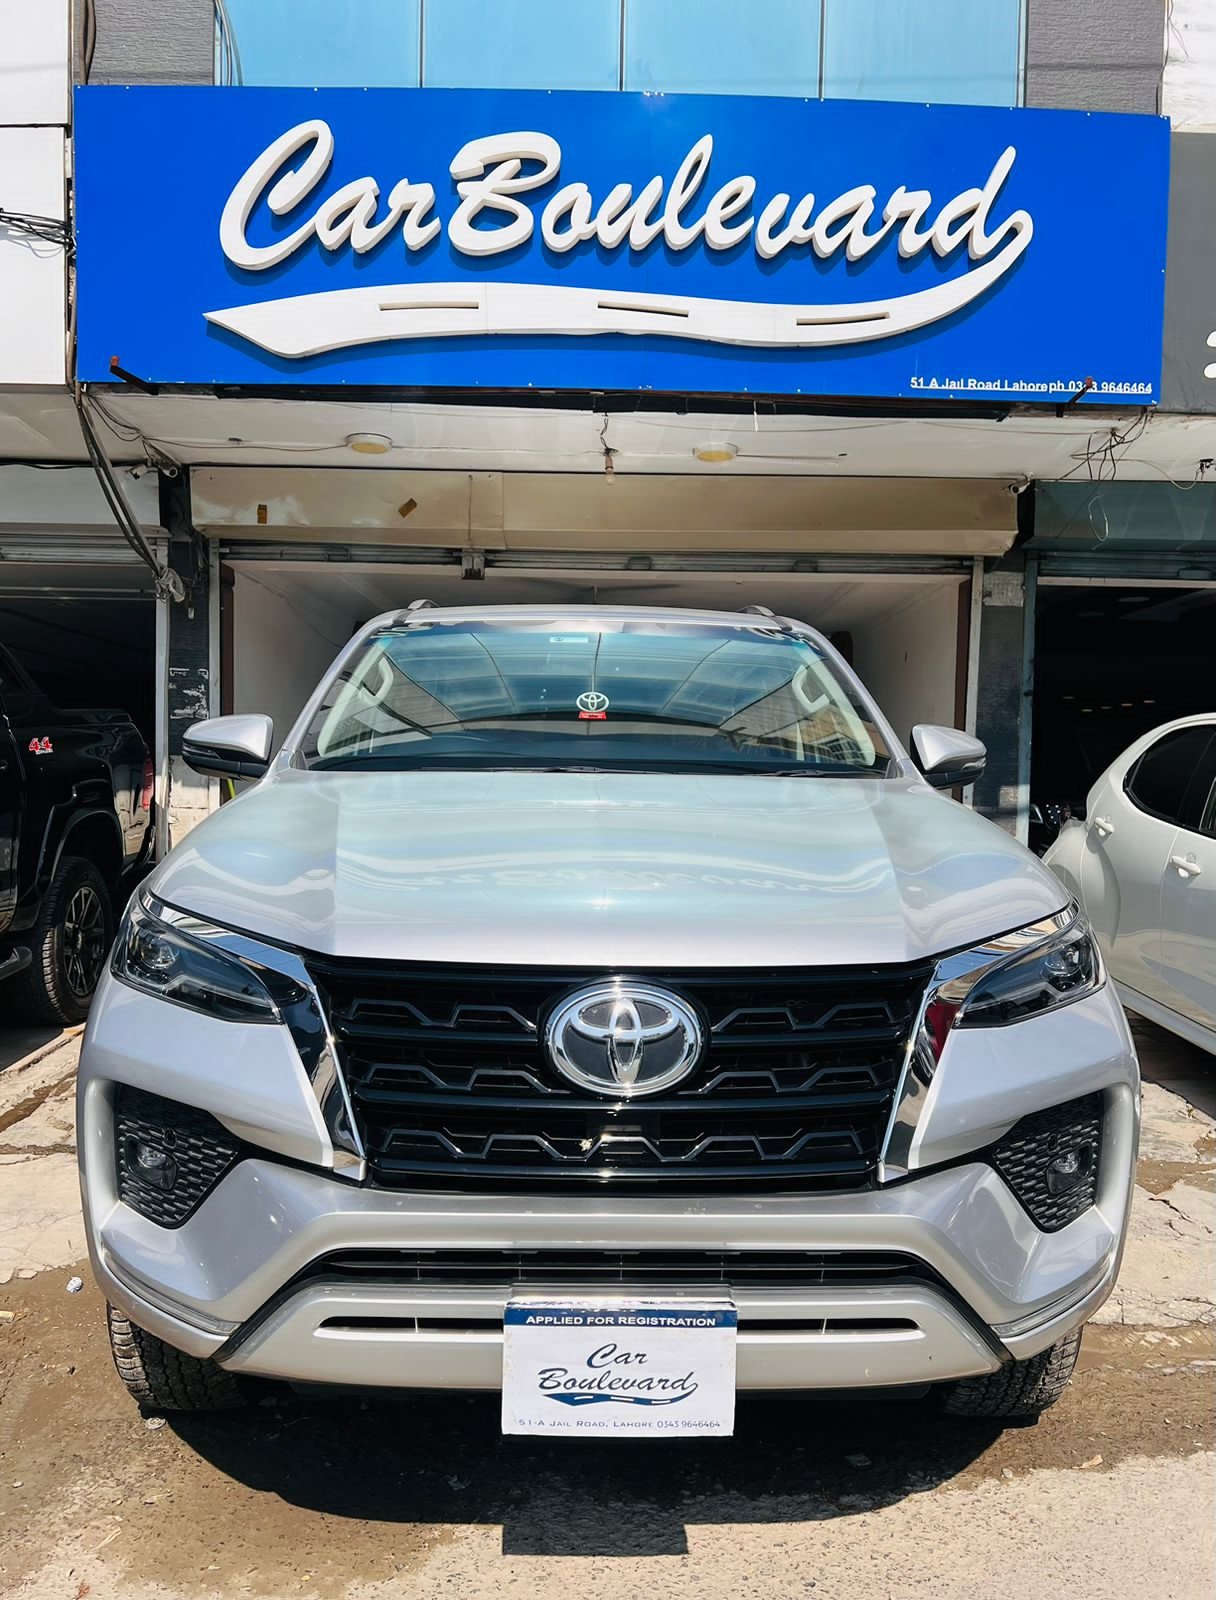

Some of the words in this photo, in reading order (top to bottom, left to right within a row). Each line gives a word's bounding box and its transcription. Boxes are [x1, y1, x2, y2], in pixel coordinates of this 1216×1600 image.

[910, 376, 924, 389] 51
[929, 377, 939, 389] A
[942, 378, 964, 390] Jail
[967, 378, 1001, 391] Road
[1068, 380, 1098, 393] 033
[1101, 381, 1152, 394] 9646464
[526, 1315, 583, 1325] APPLIED
[586, 1315, 615, 1325] FOR
[618, 1316, 716, 1327] REGISTRATION
[586, 1342, 649, 1369] Car
[537, 1367, 699, 1391] Boulevard
